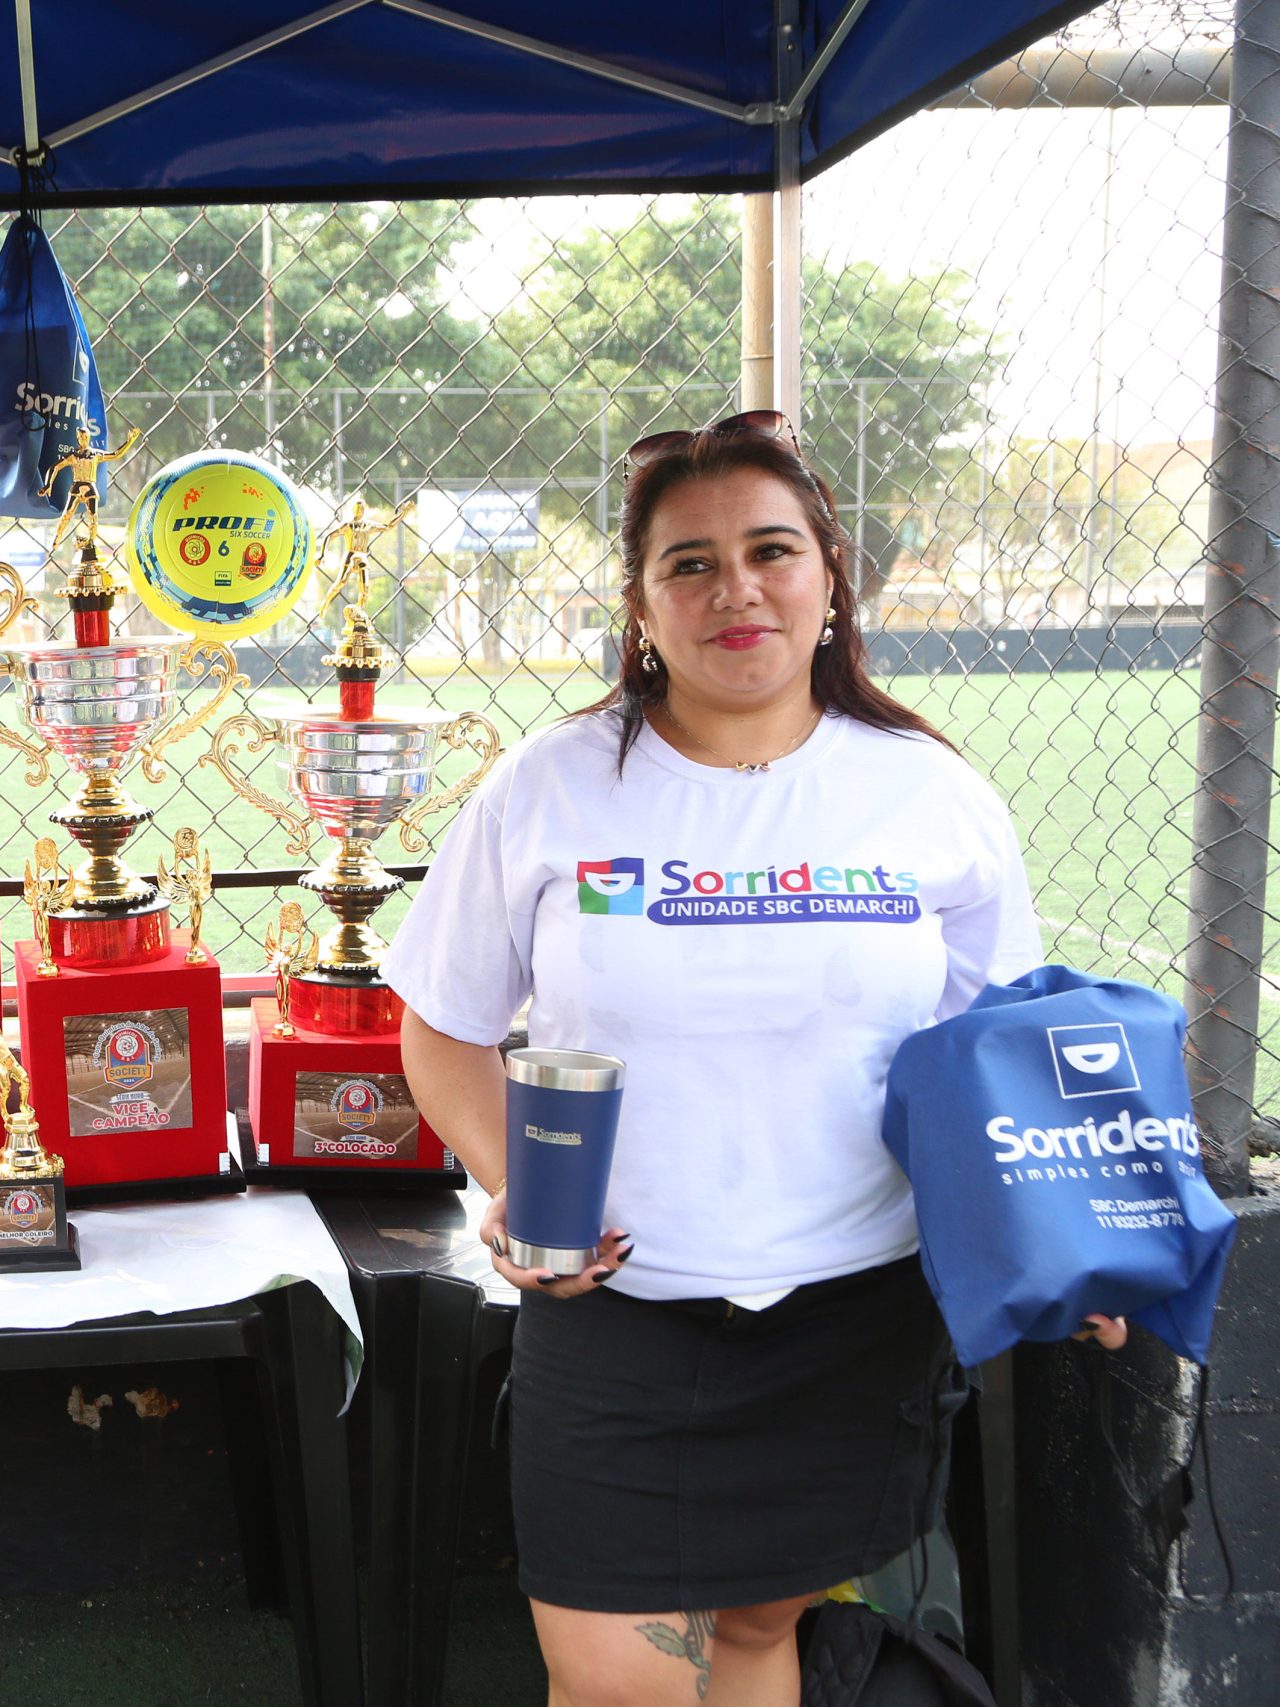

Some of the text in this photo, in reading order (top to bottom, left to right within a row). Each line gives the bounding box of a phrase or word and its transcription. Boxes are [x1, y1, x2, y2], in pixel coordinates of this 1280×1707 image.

[230, 530, 242, 538] SIX
[218, 540, 230, 556] 6
[660, 860, 919, 896] Sorridents
[661, 898, 914, 917] UNIDADE SBC DEMARCHI
[110, 1067, 147, 1078] SOCIETY
[113, 1102, 148, 1115] VICE
[93, 1113, 170, 1128] CAMPEÃO
[1001, 1164, 1089, 1185] simples
[1101, 1162, 1163, 1178] como
